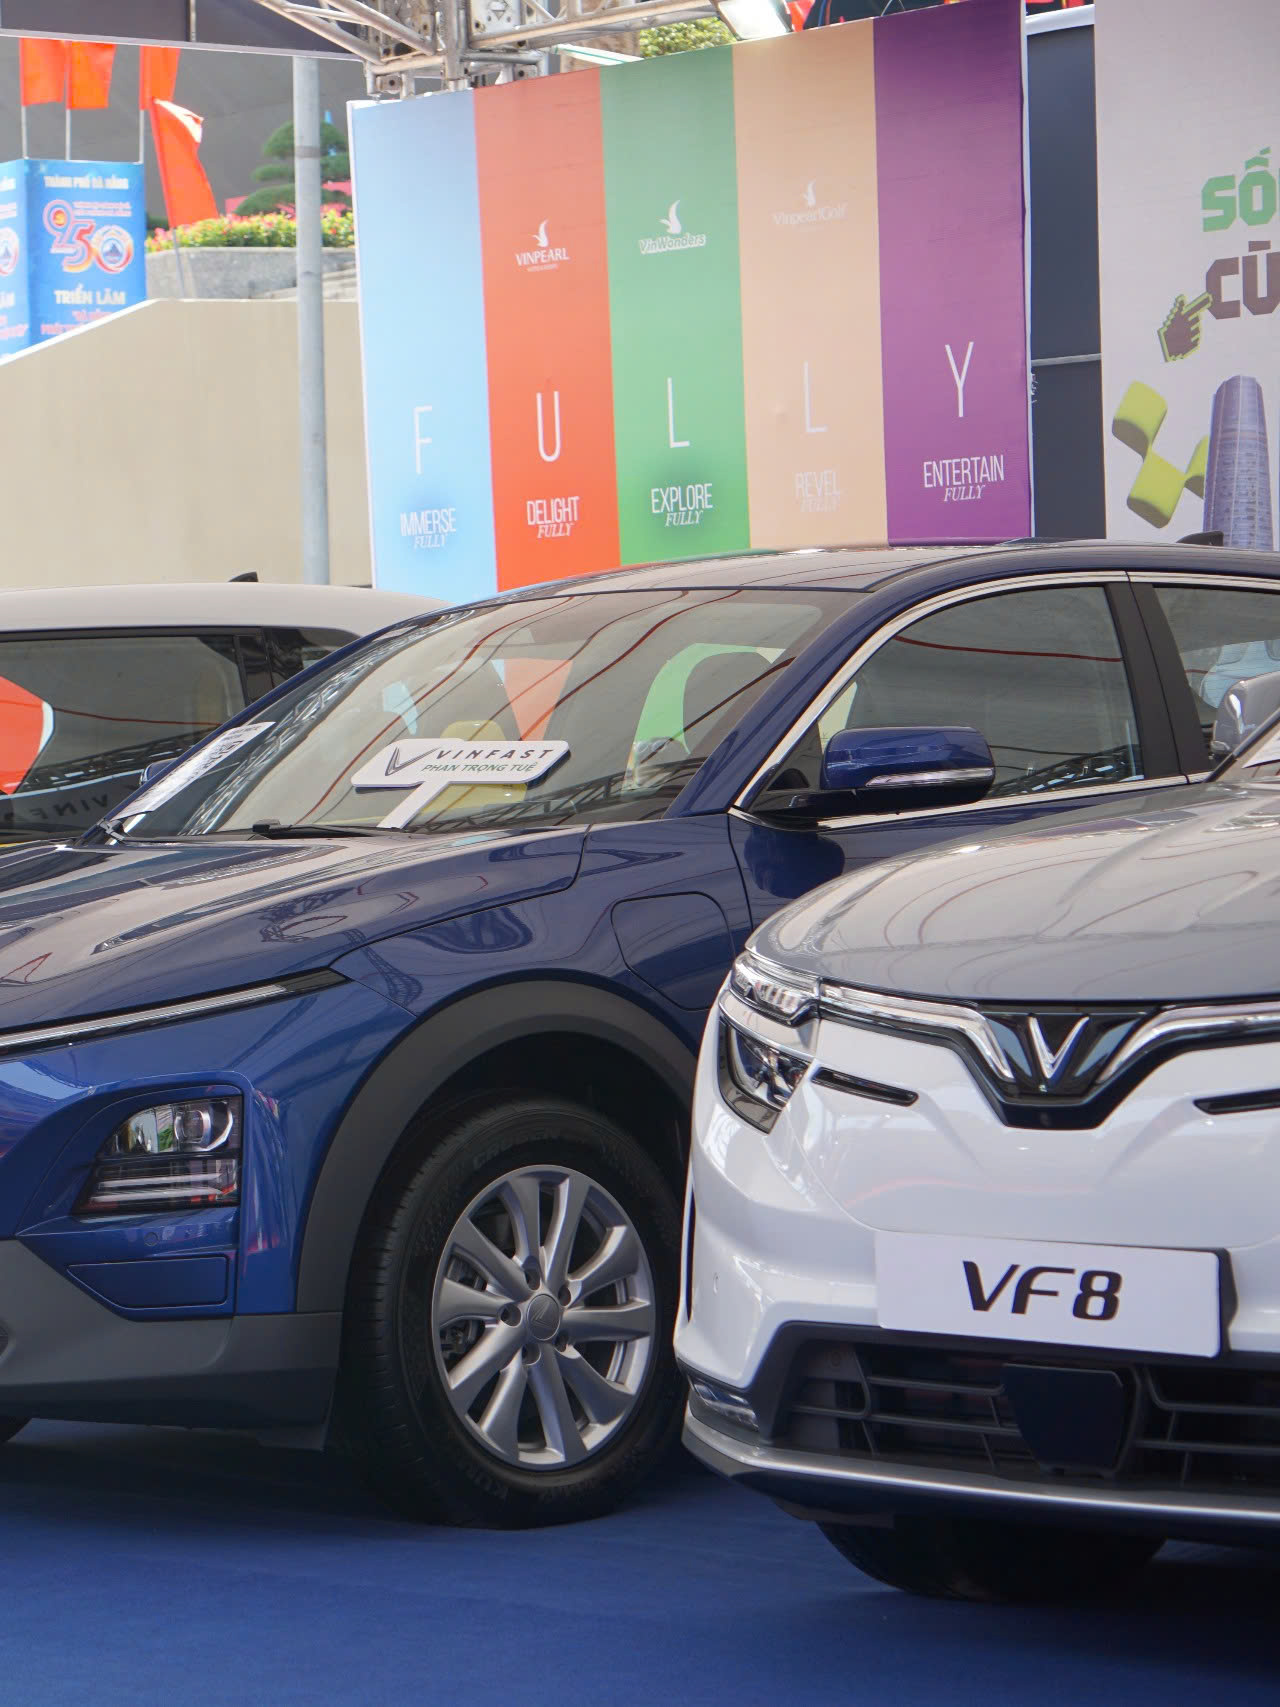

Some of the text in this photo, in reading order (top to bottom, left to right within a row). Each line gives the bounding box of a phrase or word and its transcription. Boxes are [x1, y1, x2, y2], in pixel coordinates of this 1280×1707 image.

[1201, 147, 1280, 232] SỐ
[639, 232, 706, 254] VinWonders
[515, 247, 570, 266] VINPEARL
[793, 470, 841, 497] REVEL
[923, 455, 1005, 488] ENTERTAIN
[650, 483, 713, 514] EXPLORE
[944, 485, 986, 502] FULLY
[400, 507, 457, 537] IMMERSE
[526, 496, 580, 526] DELIGHT
[665, 511, 703, 528] FULLY
[537, 522, 574, 539] FULLY
[436, 749, 553, 760] VINFAST
[421, 764, 460, 772] PHAN
[962, 1260, 1124, 1321] VF8
